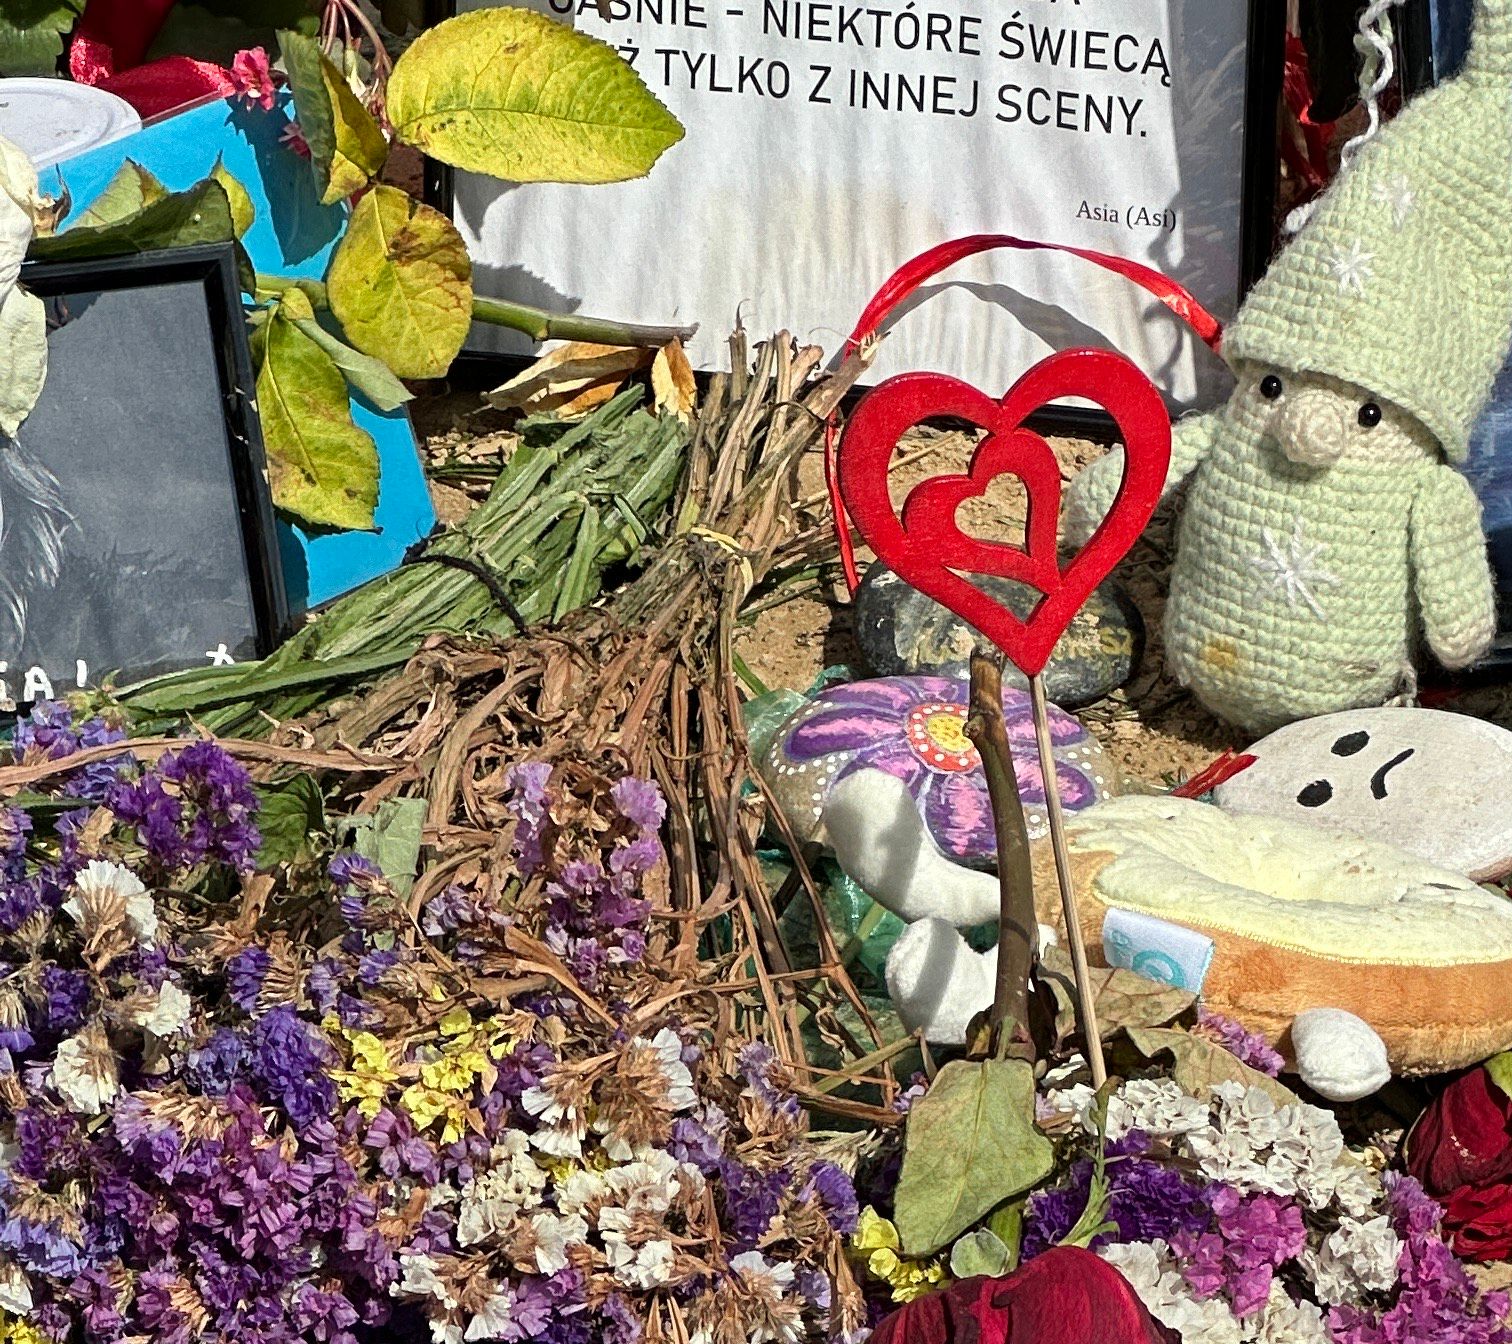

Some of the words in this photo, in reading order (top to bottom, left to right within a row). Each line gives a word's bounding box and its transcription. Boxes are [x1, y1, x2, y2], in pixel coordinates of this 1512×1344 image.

[764, 1, 982, 56] NIEKTÓRE
[999, 12, 1171, 87] ŚWIECĄ
[656, 49, 789, 100] TYLKO
[809, 66, 831, 104] Z
[849, 70, 979, 118] INNEJ
[996, 85, 1147, 137] SCENY.
[1077, 200, 1121, 225] Asia
[1126, 203, 1178, 231] (Asi)
